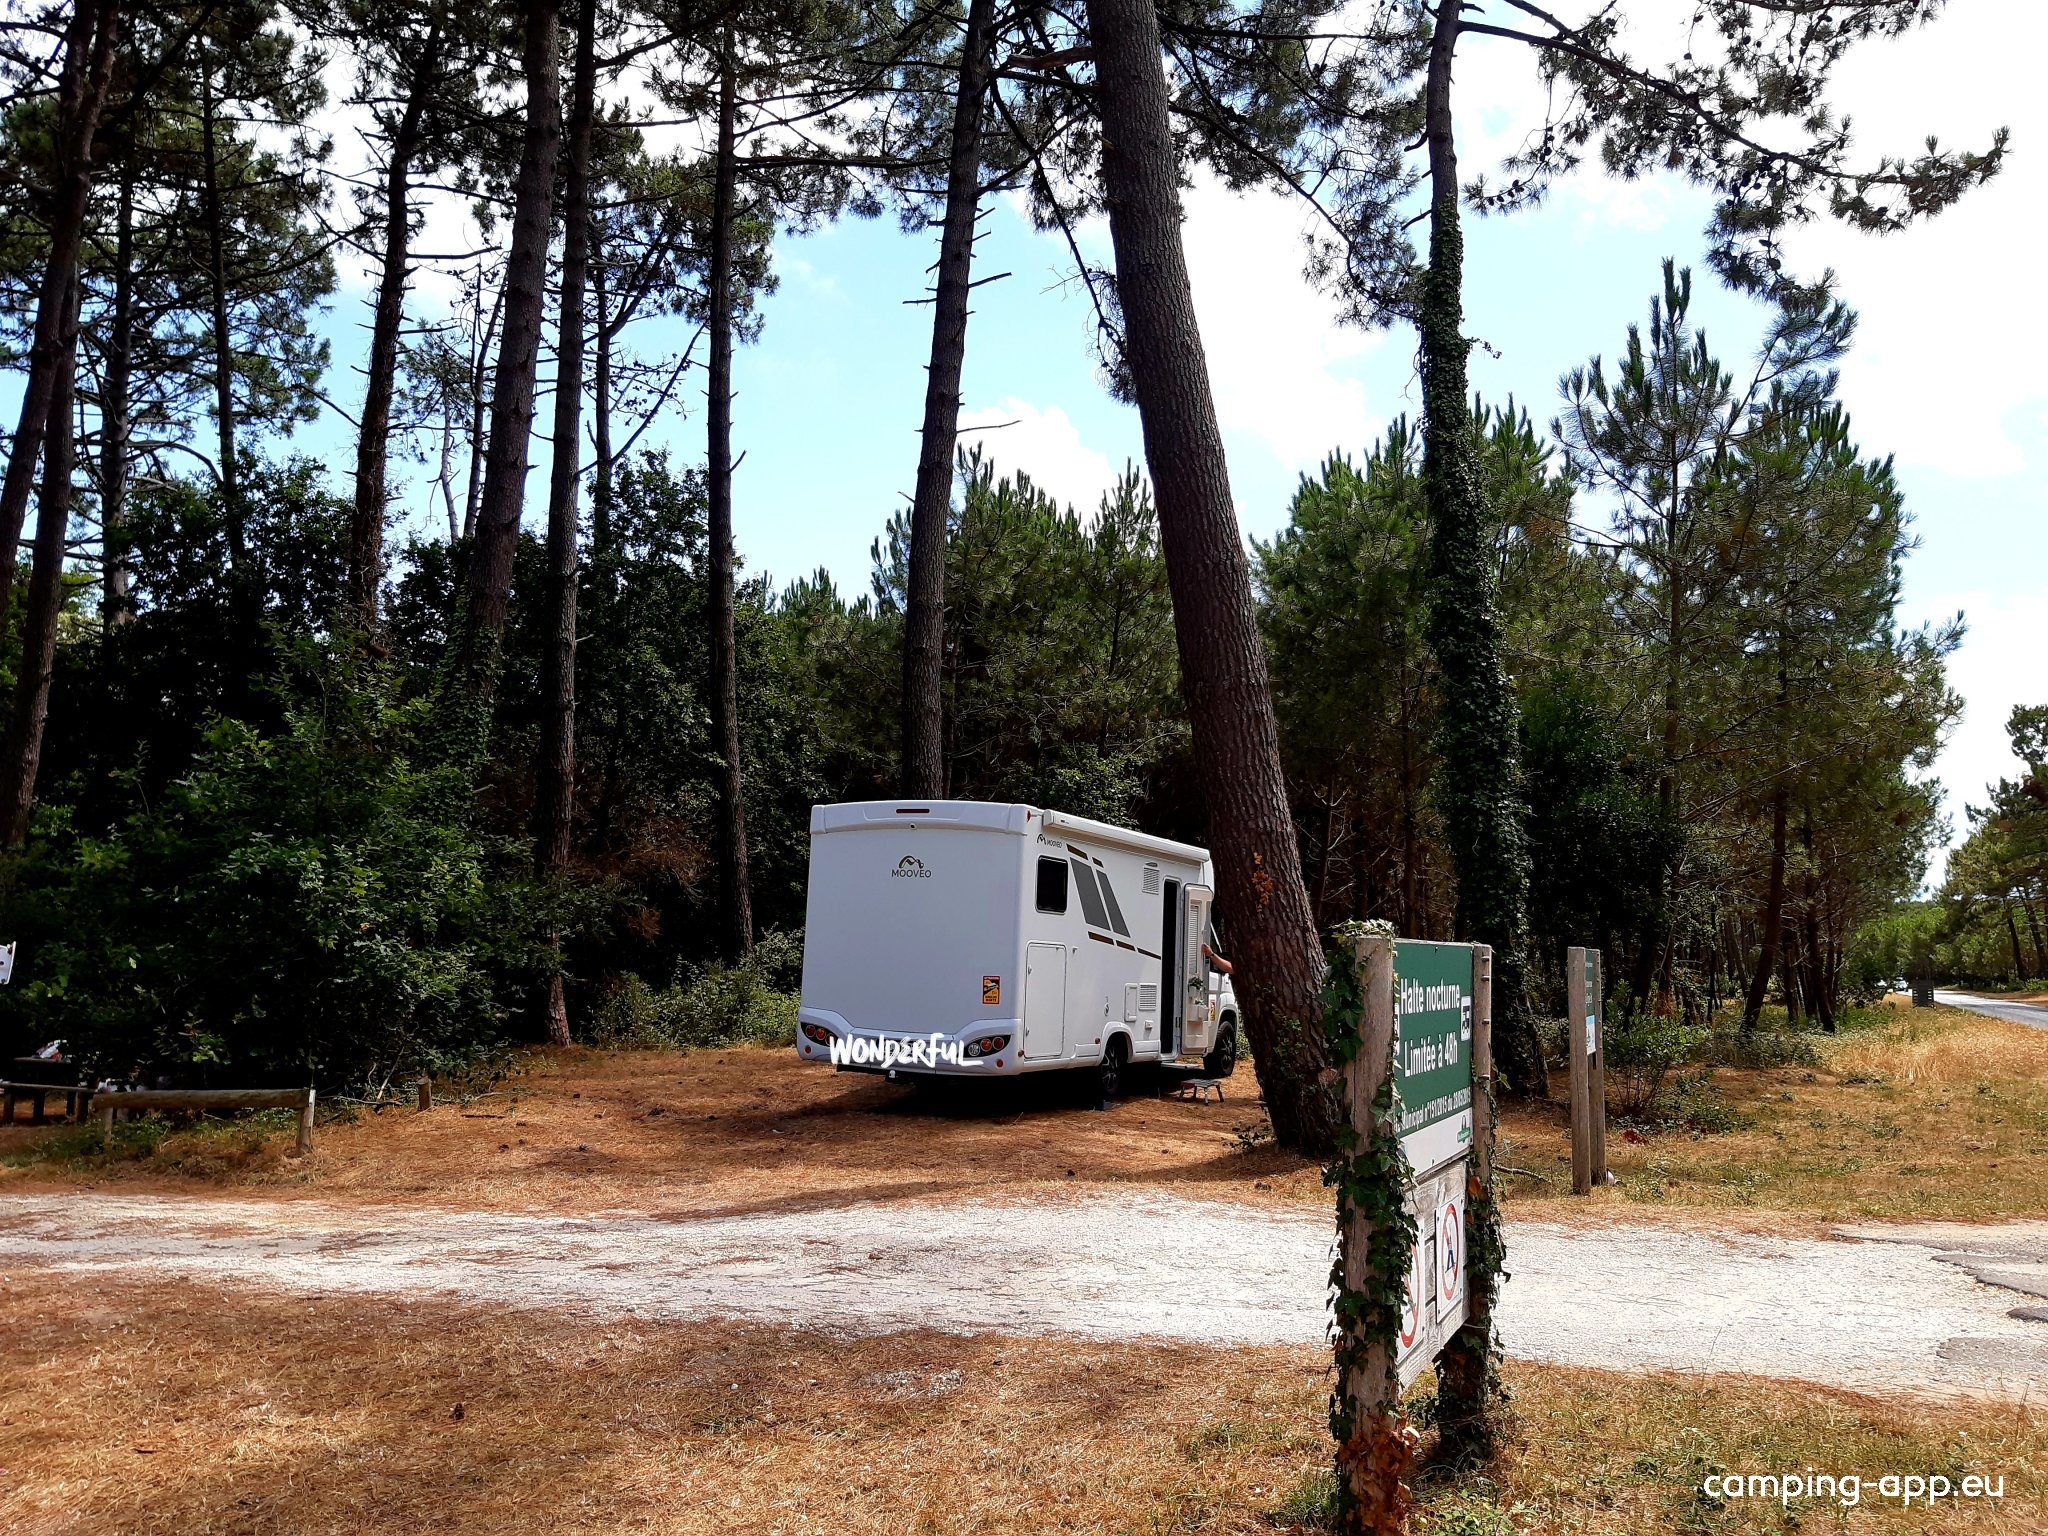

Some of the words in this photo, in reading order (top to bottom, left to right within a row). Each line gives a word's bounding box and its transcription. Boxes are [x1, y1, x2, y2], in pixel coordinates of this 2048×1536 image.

[891, 869, 932, 878] MOOVEO
[1400, 978, 1424, 1015] Halte
[1426, 977, 1460, 1012] nocturne
[1404, 1035, 1436, 1078] Limitée
[1438, 1033, 1443, 1069] à
[1444, 1032, 1458, 1066] 48h
